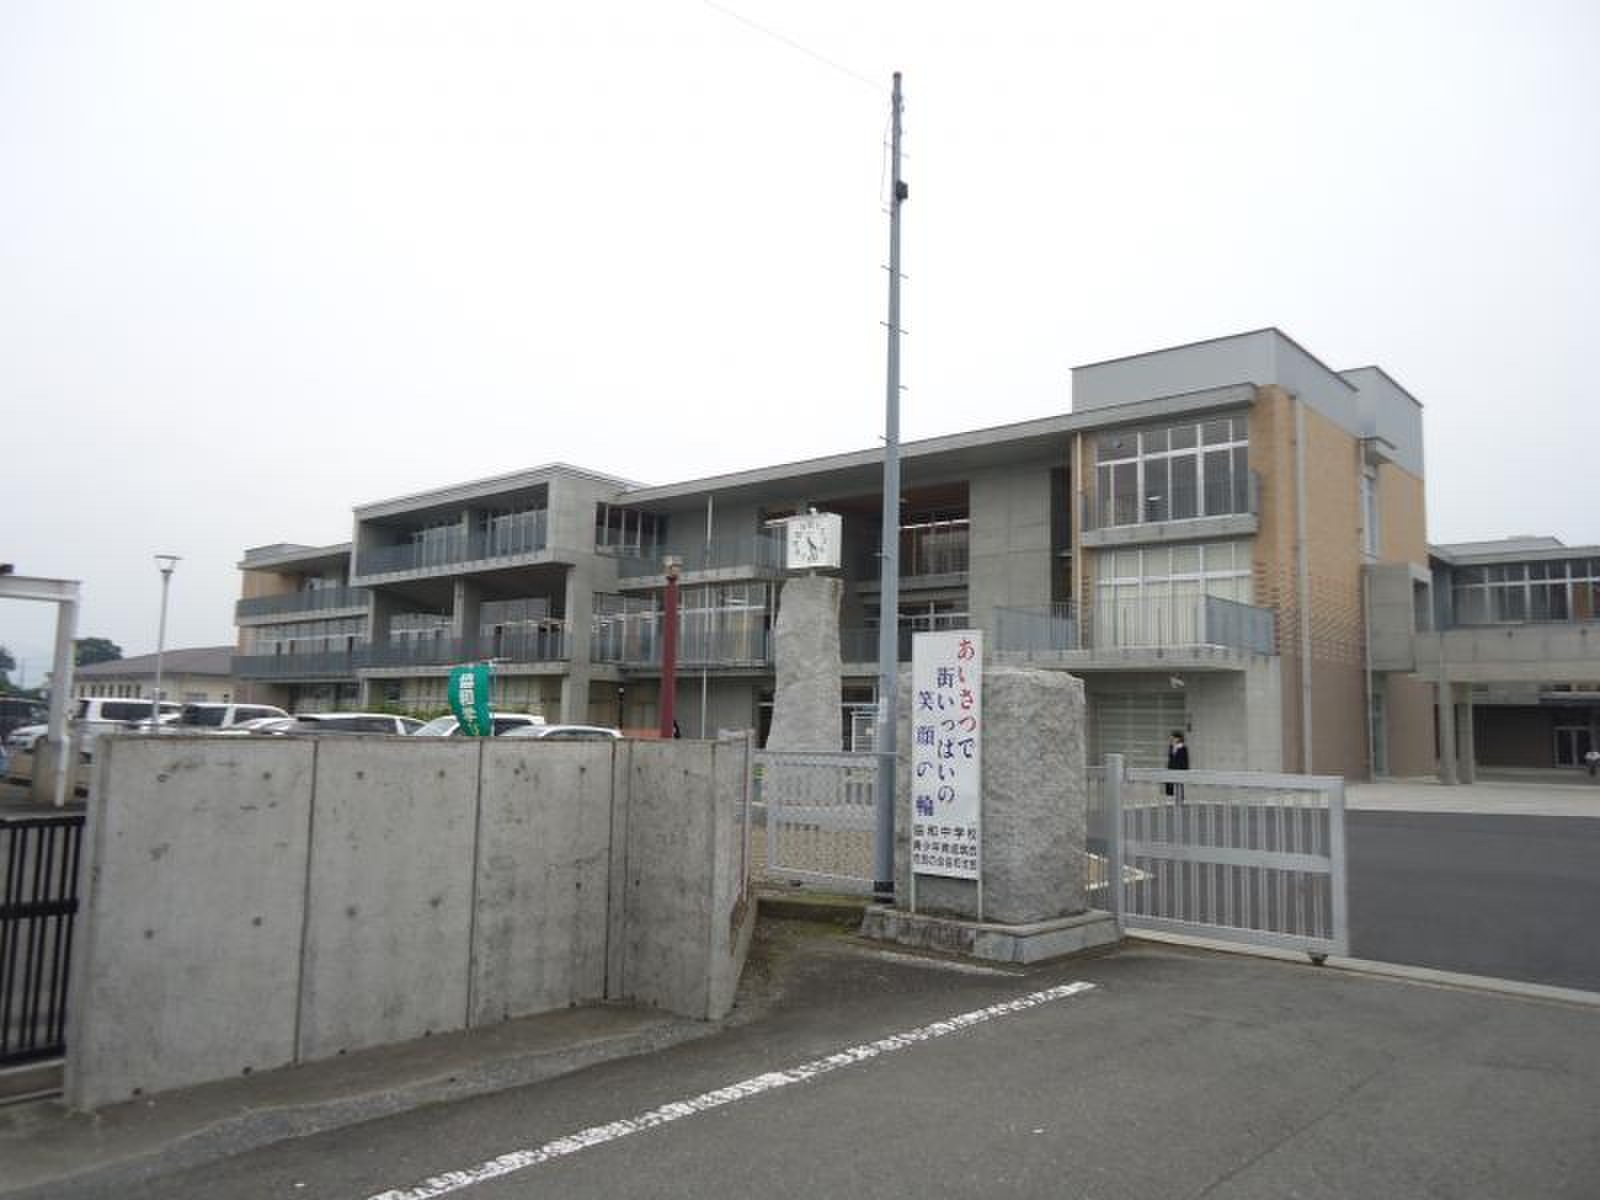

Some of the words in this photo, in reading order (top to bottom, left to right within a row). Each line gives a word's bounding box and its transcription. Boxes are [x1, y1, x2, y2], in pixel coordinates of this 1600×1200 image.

[957, 639, 976, 758] あいさつで
